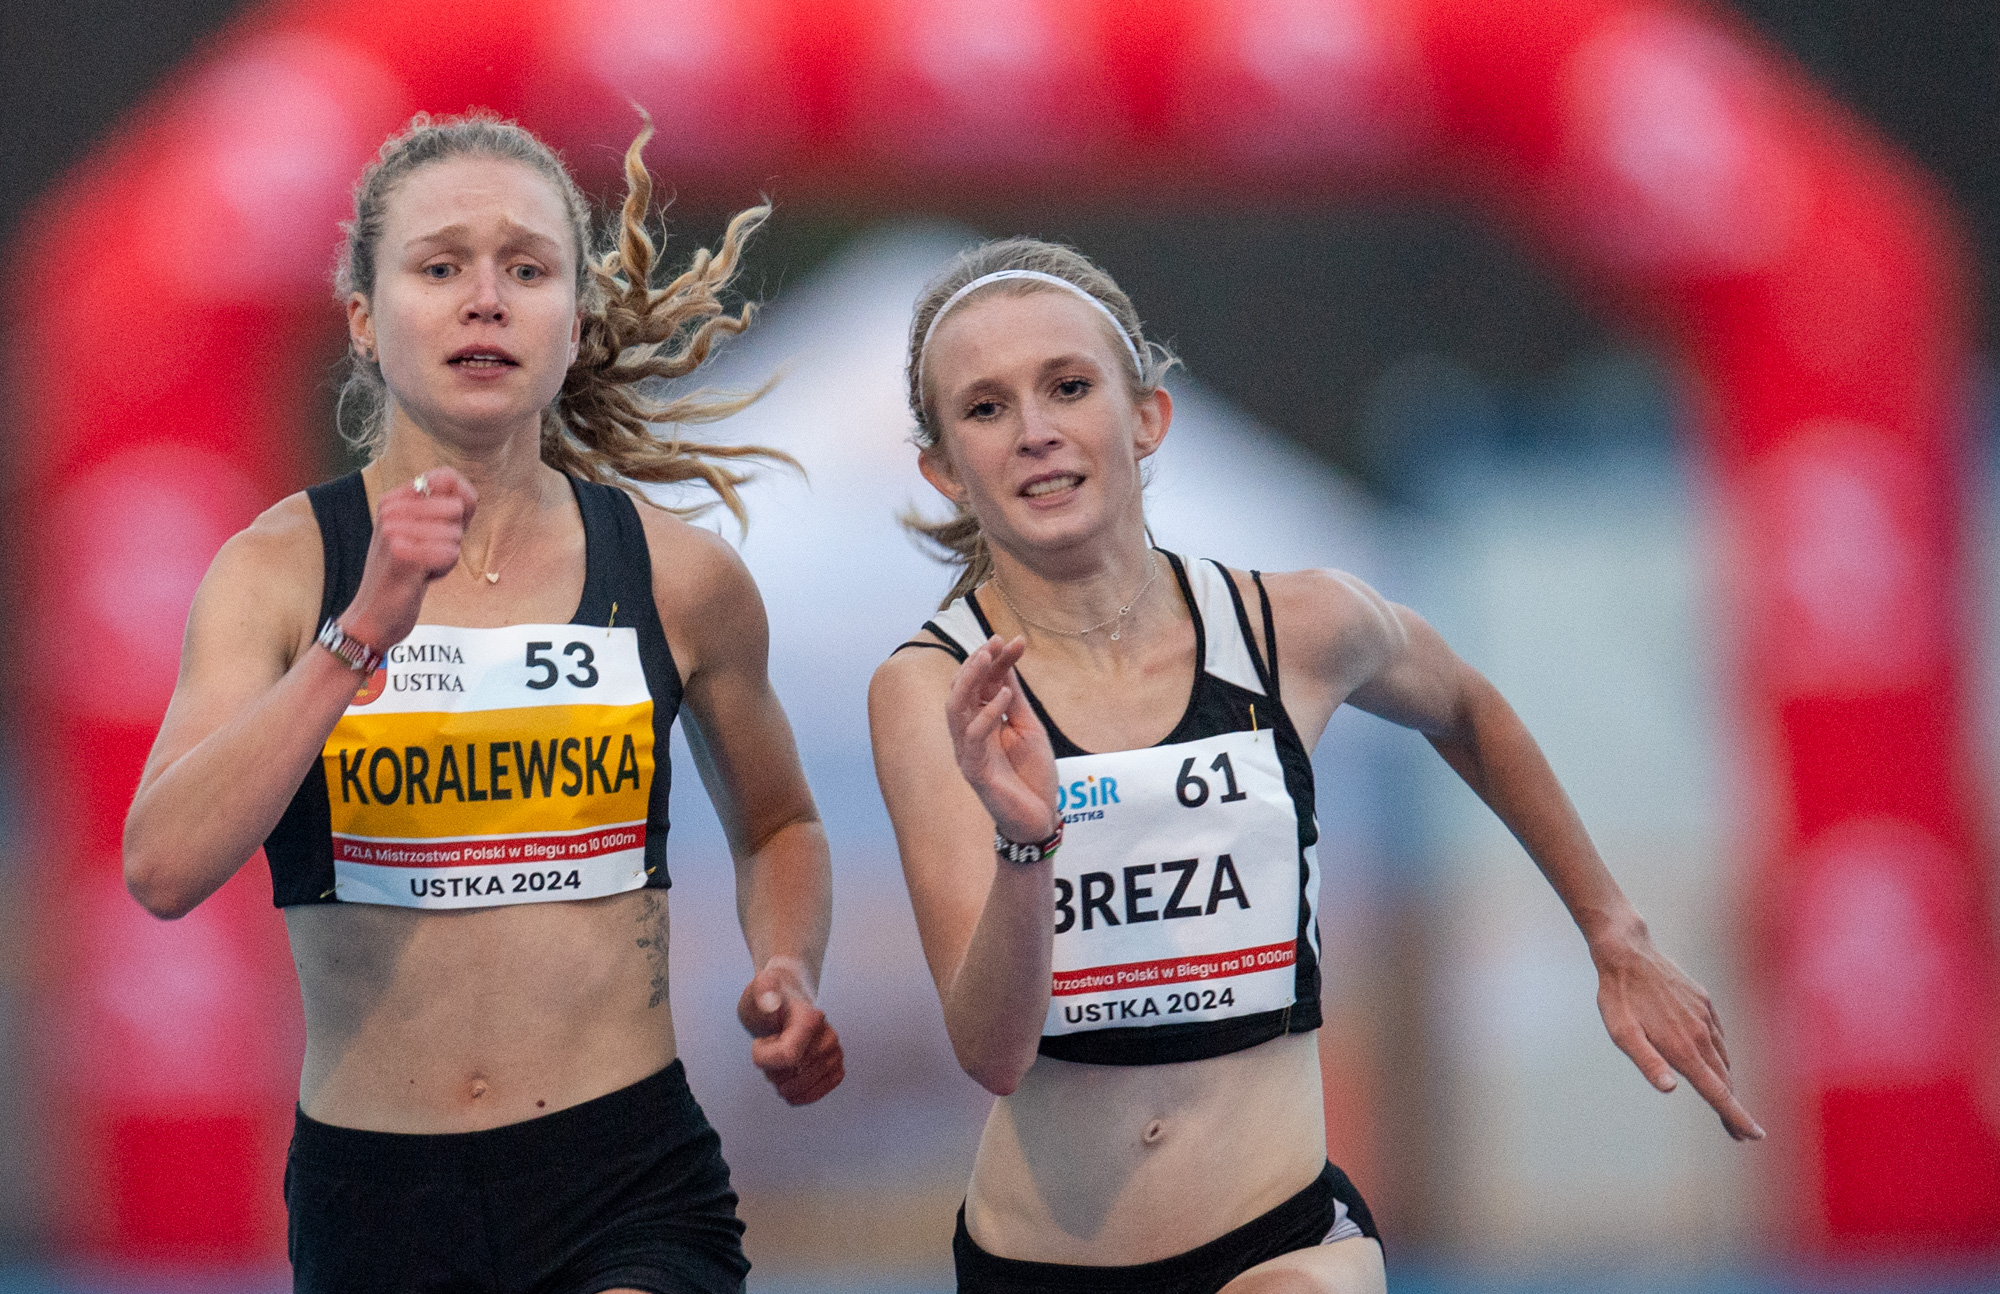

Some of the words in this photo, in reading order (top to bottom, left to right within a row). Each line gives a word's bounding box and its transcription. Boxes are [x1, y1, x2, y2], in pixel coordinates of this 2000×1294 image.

[390, 644, 466, 664] GMINA
[524, 641, 600, 690] 53
[392, 672, 466, 693] USTKA
[339, 734, 641, 806] KORALEWSKA
[1175, 752, 1247, 808] 61
[343, 844, 373, 860] PZLA
[375, 848, 461, 863] Mistrzostwa
[463, 844, 506, 861] Polski
[508, 846, 521, 858] w
[524, 843, 566, 859] Biegu
[569, 843, 587, 854] na
[588, 838, 600, 851] 10
[601, 832, 637, 849] 000m
[410, 876, 505, 898] USTKA
[512, 869, 582, 893] 2024
[1053, 974, 1114, 991] trzostwa
[1116, 966, 1159, 984] Polski
[1161, 967, 1175, 979] w
[1177, 962, 1219, 978] Biegu
[1221, 959, 1239, 972] na
[1241, 954, 1255, 968] 10
[1257, 949, 1294, 966] 000m
[1064, 997, 1160, 1024] USTKA
[1166, 987, 1235, 1014] 2024
